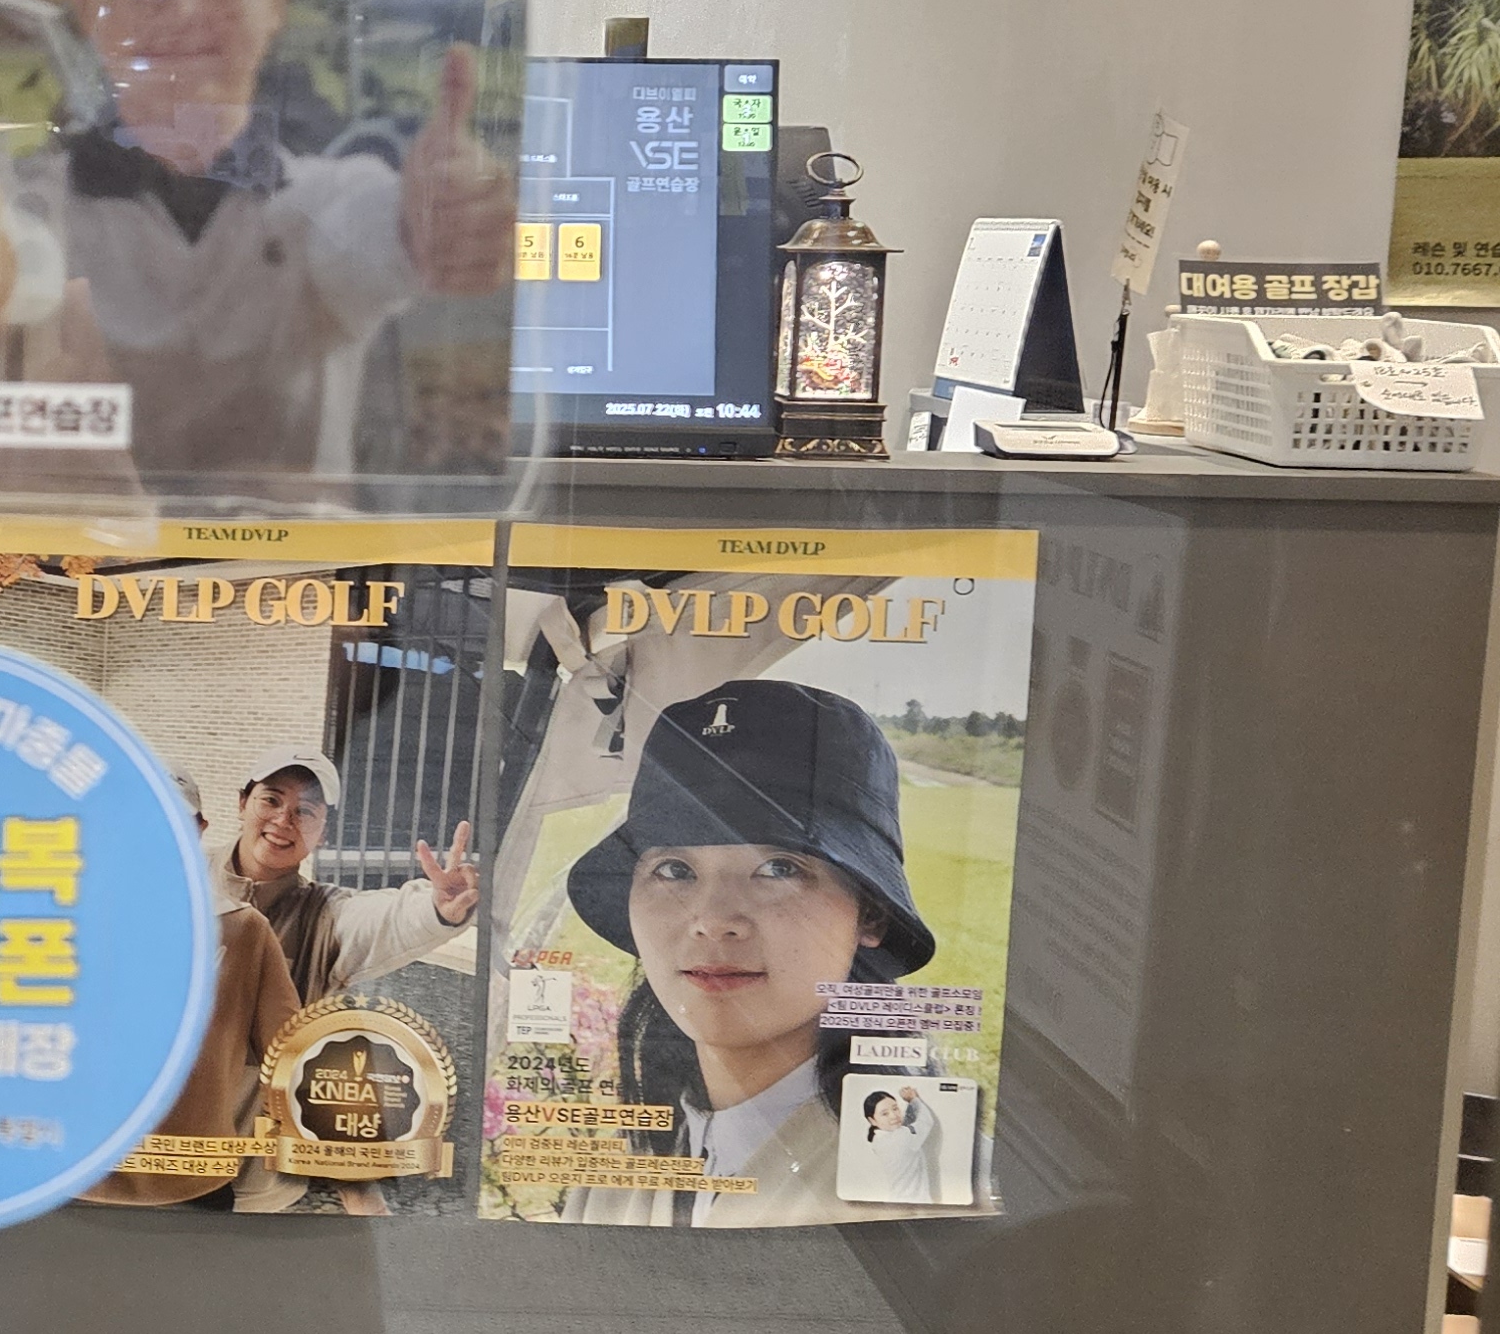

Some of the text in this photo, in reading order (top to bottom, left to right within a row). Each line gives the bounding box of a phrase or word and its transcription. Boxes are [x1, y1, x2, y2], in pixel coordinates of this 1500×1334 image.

[632, 86, 697, 101] 디브이엘피
[635, 106, 694, 134] 용산
[626, 176, 700, 193] 골프연습장
[523, 235, 535, 248] 5
[574, 235, 585, 248] 6
[1412, 241, 1446, 257] 레슨
[1180, 272, 1380, 301] 대여용 골프 장갑
[183, 525, 289, 543] TEAM DVLP
[718, 539, 826, 557] TEAM DVLP
[73, 572, 404, 628] DVLP GOLF
[603, 585, 945, 644] DVLP GOLF
[850, 1000, 880, 1012] DVLP
[856, 1044, 922, 1059] LADIES
[507, 1055, 591, 1073] 2024년도
[315, 1068, 348, 1080] 2024
[310, 1080, 378, 1103] KNBA
[506, 1075, 556, 1095] 화제의
[505, 1104, 675, 1128] 용산VSE골프연습장
[334, 1112, 382, 1139] 대상
[179, 1140, 218, 1153] 브랜드
[221, 1141, 247, 1155] 대상
[250, 1142, 278, 1155] 수상
[291, 1144, 320, 1155] 2024
[182, 1160, 208, 1174] 대상
[211, 1161, 239, 1175] 수상
